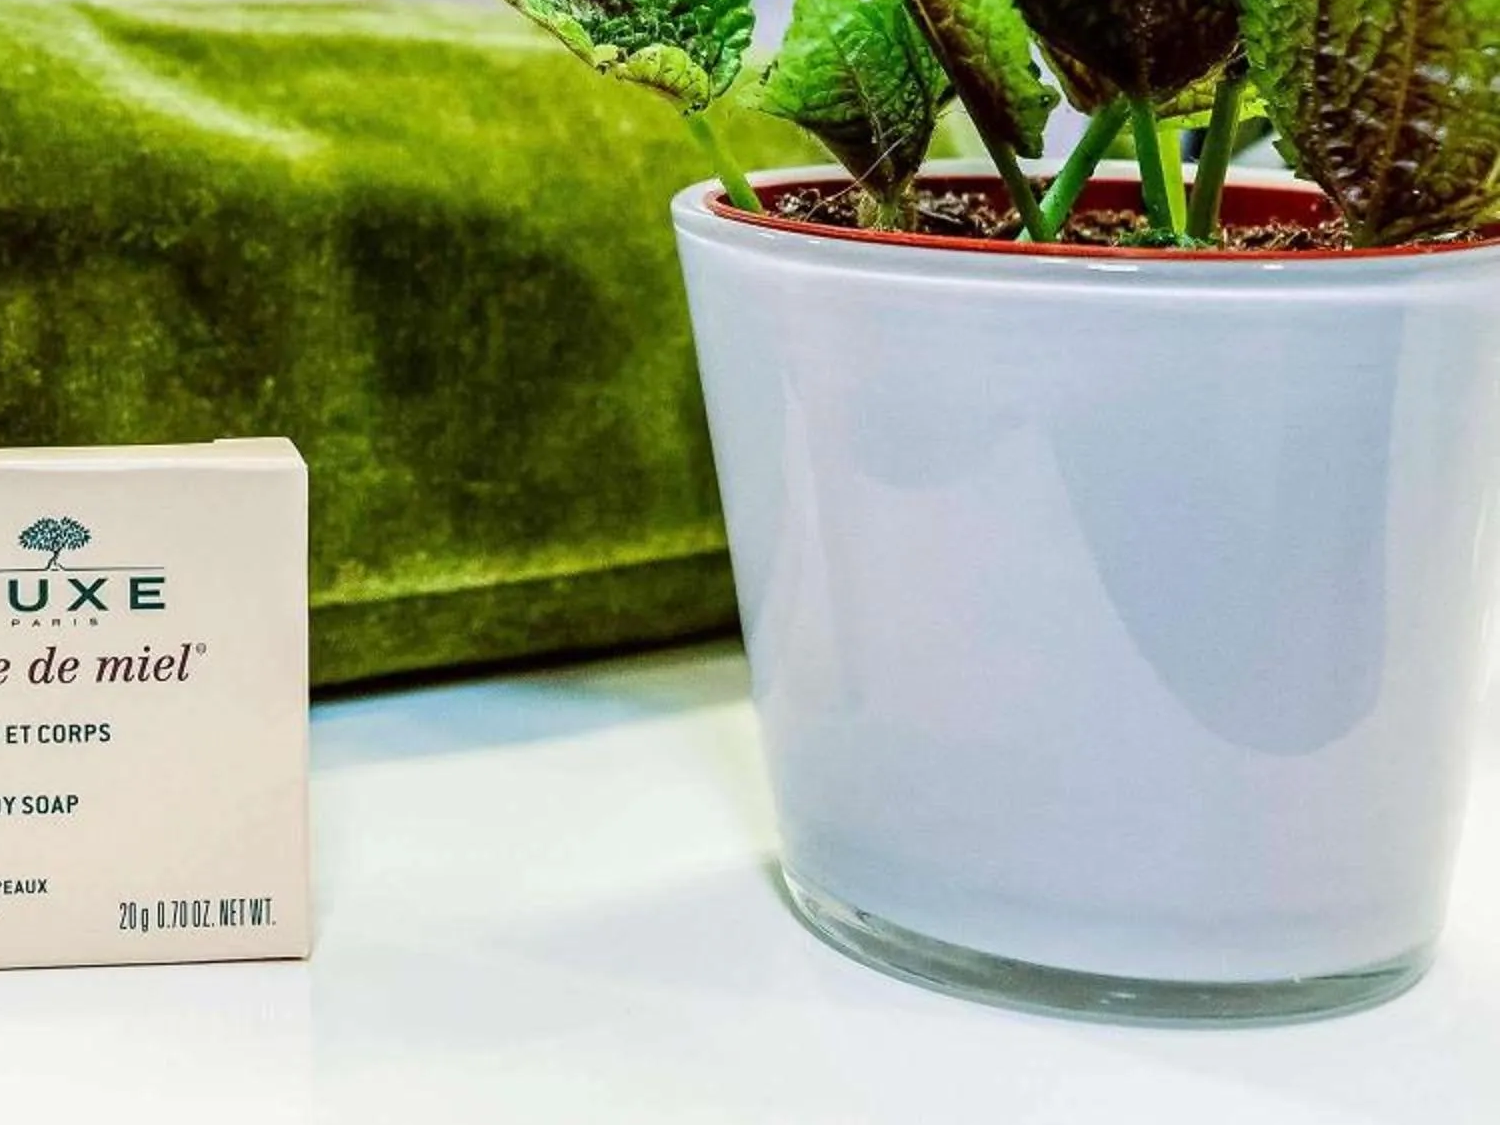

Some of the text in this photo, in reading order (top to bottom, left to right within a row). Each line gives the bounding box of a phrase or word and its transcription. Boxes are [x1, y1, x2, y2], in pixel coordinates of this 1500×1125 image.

[11, 617, 98, 627] PARIS
[28, 647, 80, 684] de
[5, 725, 31, 745] ET
[37, 723, 111, 744] CORPS
[22, 794, 79, 815] SOAP
[156, 901, 188, 930] 0.70
[192, 900, 216, 928] OZ.
[219, 899, 246, 927] NET
[249, 898, 277, 926] WT.
